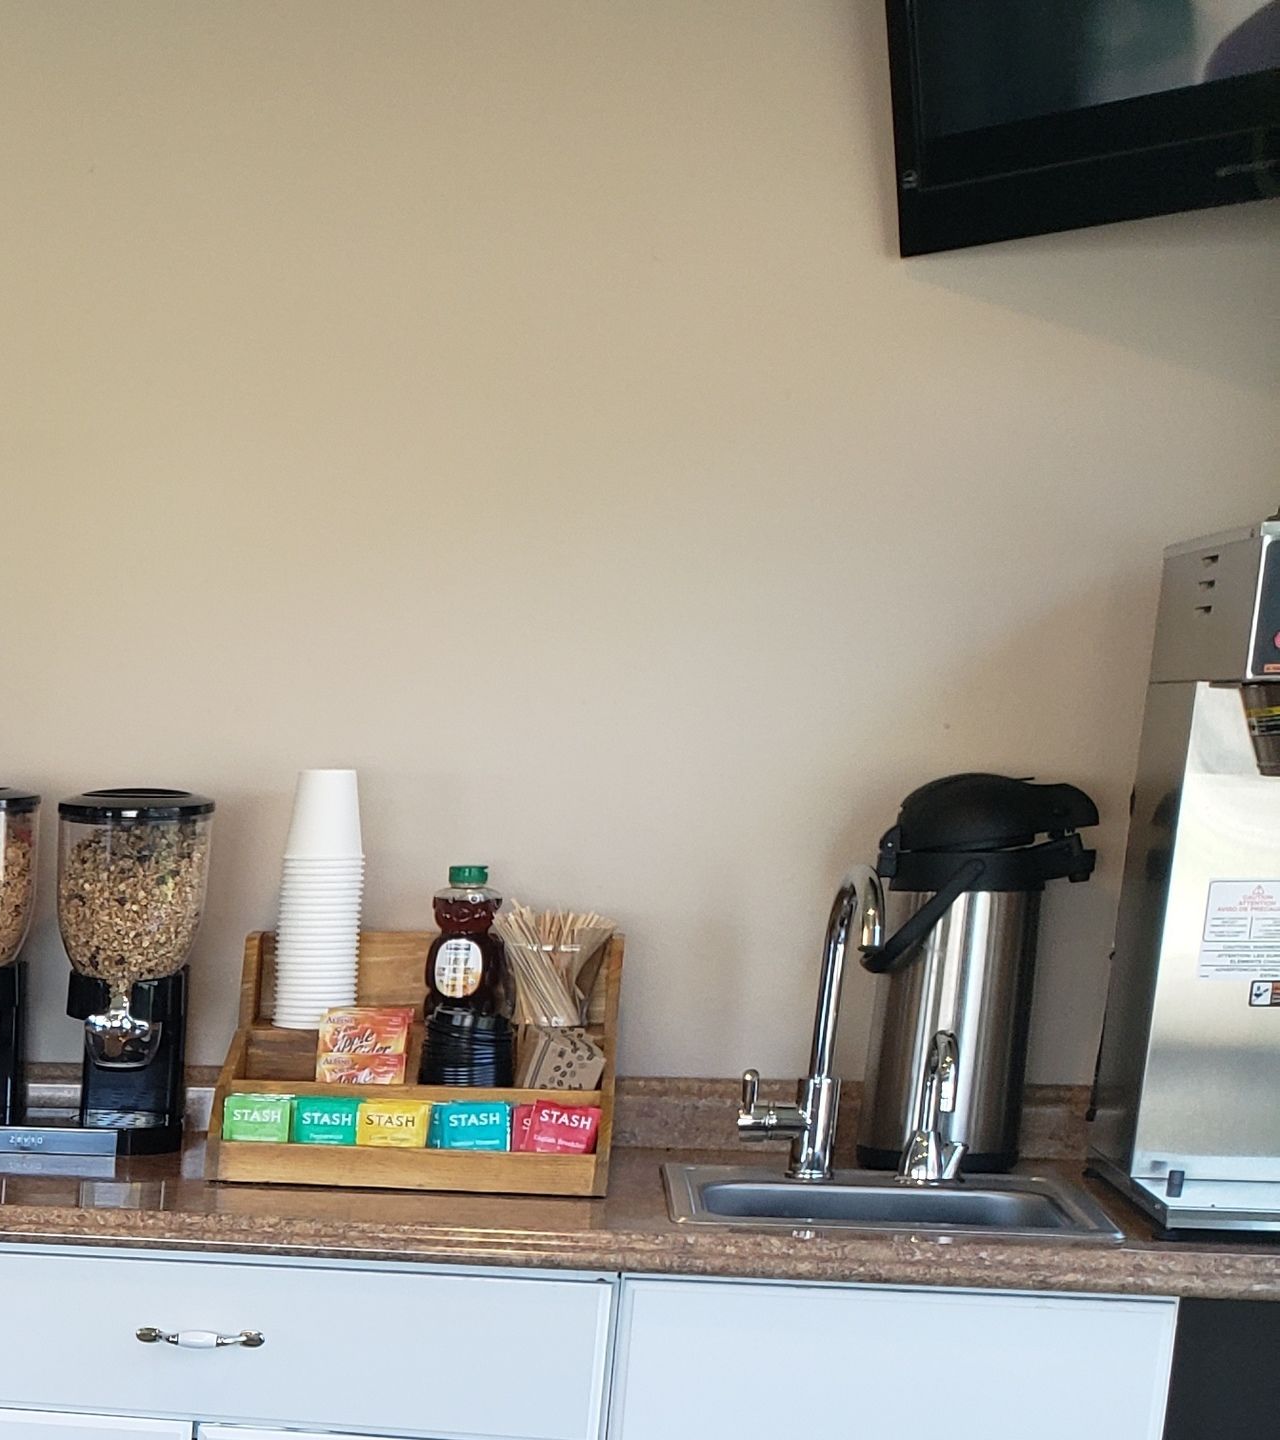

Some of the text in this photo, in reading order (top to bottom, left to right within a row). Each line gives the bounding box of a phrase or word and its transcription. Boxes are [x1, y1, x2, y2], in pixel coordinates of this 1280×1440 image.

[233, 1109, 281, 1123] STASH
[302, 1112, 352, 1126] STASH
[366, 1114, 415, 1127] STASH
[449, 1112, 500, 1127] STASH
[540, 1109, 593, 1130] STASH
